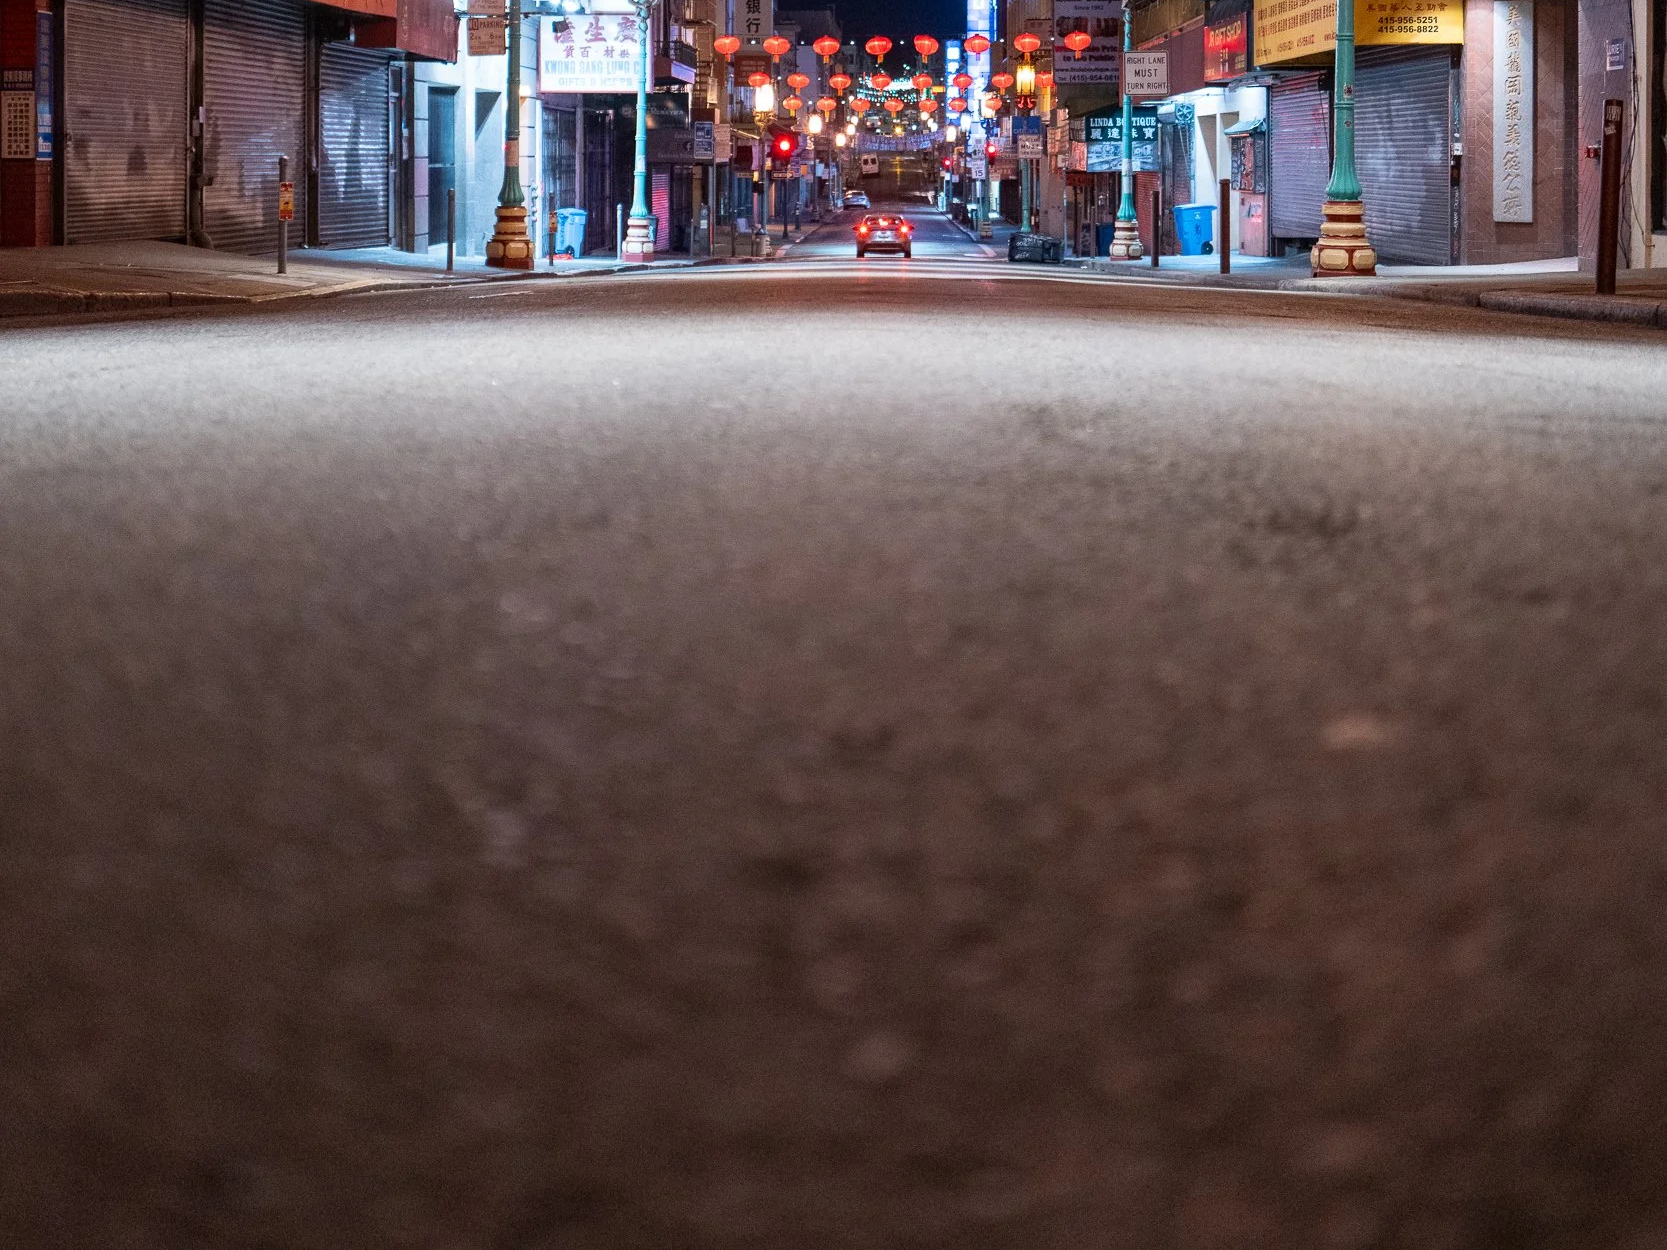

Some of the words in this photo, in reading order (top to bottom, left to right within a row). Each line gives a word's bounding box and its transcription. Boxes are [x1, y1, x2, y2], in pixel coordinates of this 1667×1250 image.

[1378, 16, 1439, 24] 415-956-5251
[479, 21, 504, 29] PARKING
[1378, 25, 1439, 34] 415-956-8822
[1126, 56, 1145, 65] RIGHT
[1148, 56, 1166, 65] LANE
[544, 59, 576, 75] KWONG
[579, 59, 604, 75] SANG
[1134, 68, 1159, 78] MUST
[1127, 82, 1145, 91] TURN
[1146, 82, 1167, 91] RIGHT
[1090, 117, 1114, 127] LINDA
[1116, 117, 1157, 127] BTIQUE
